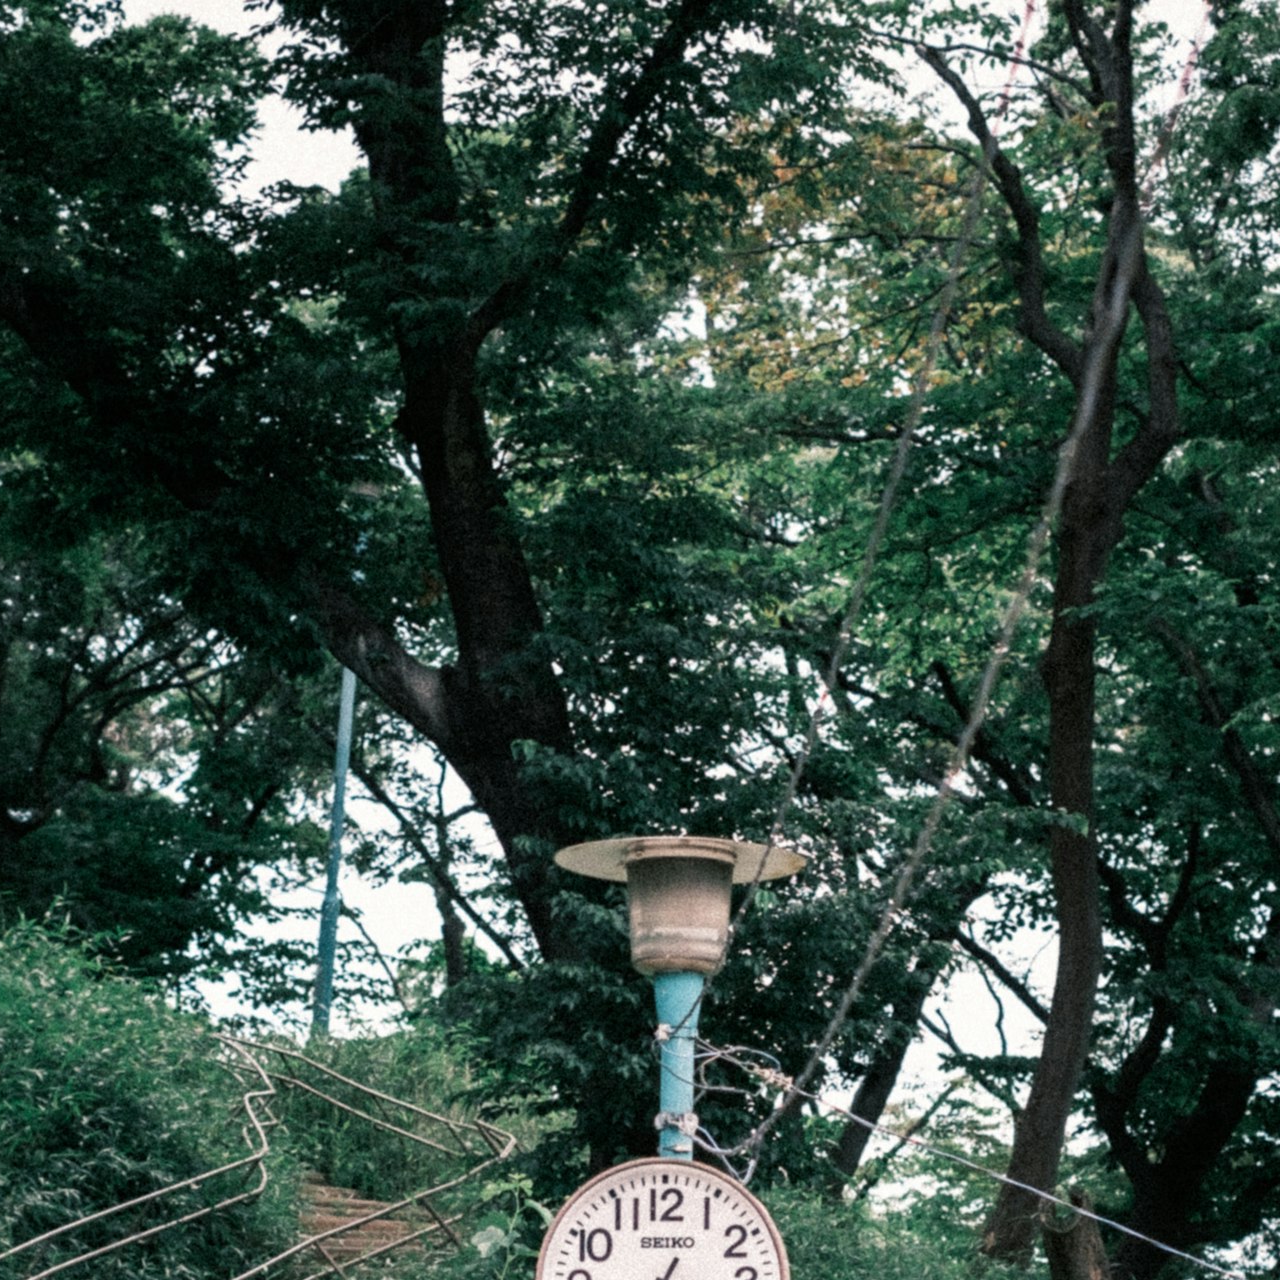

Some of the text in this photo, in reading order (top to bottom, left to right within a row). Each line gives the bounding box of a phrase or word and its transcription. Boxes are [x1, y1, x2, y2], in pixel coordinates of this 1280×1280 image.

[615, 1197, 639, 1231] 11
[650, 1188, 684, 1222] 12
[703, 1197, 711, 1230] 1
[579, 1228, 613, 1262] 10
[640, 1236, 695, 1249] SEIKO
[723, 1225, 748, 1258] 2
